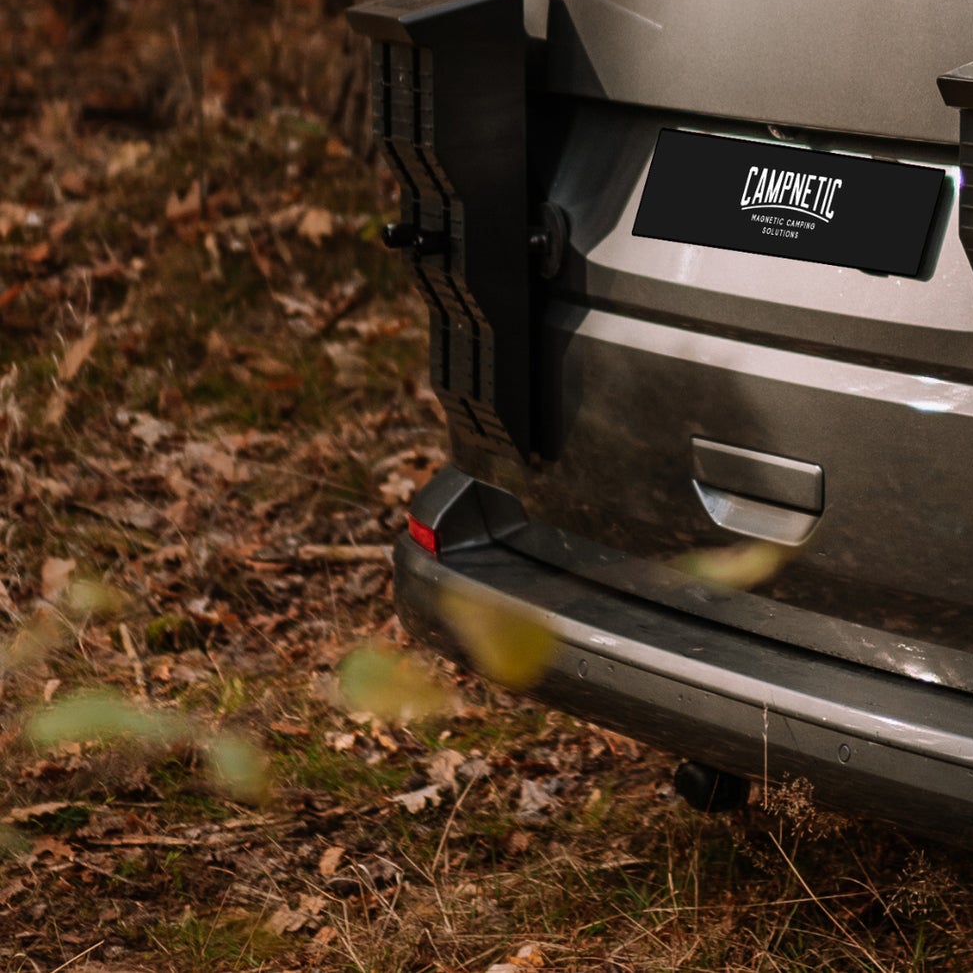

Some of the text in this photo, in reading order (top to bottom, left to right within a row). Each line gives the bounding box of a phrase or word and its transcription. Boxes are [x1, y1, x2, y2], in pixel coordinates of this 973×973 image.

[740, 165, 843, 220] CAMPNETIC
[751, 213, 816, 230] MAGNETIC CAMPING
[761, 226, 800, 239] SOLUTIONS
